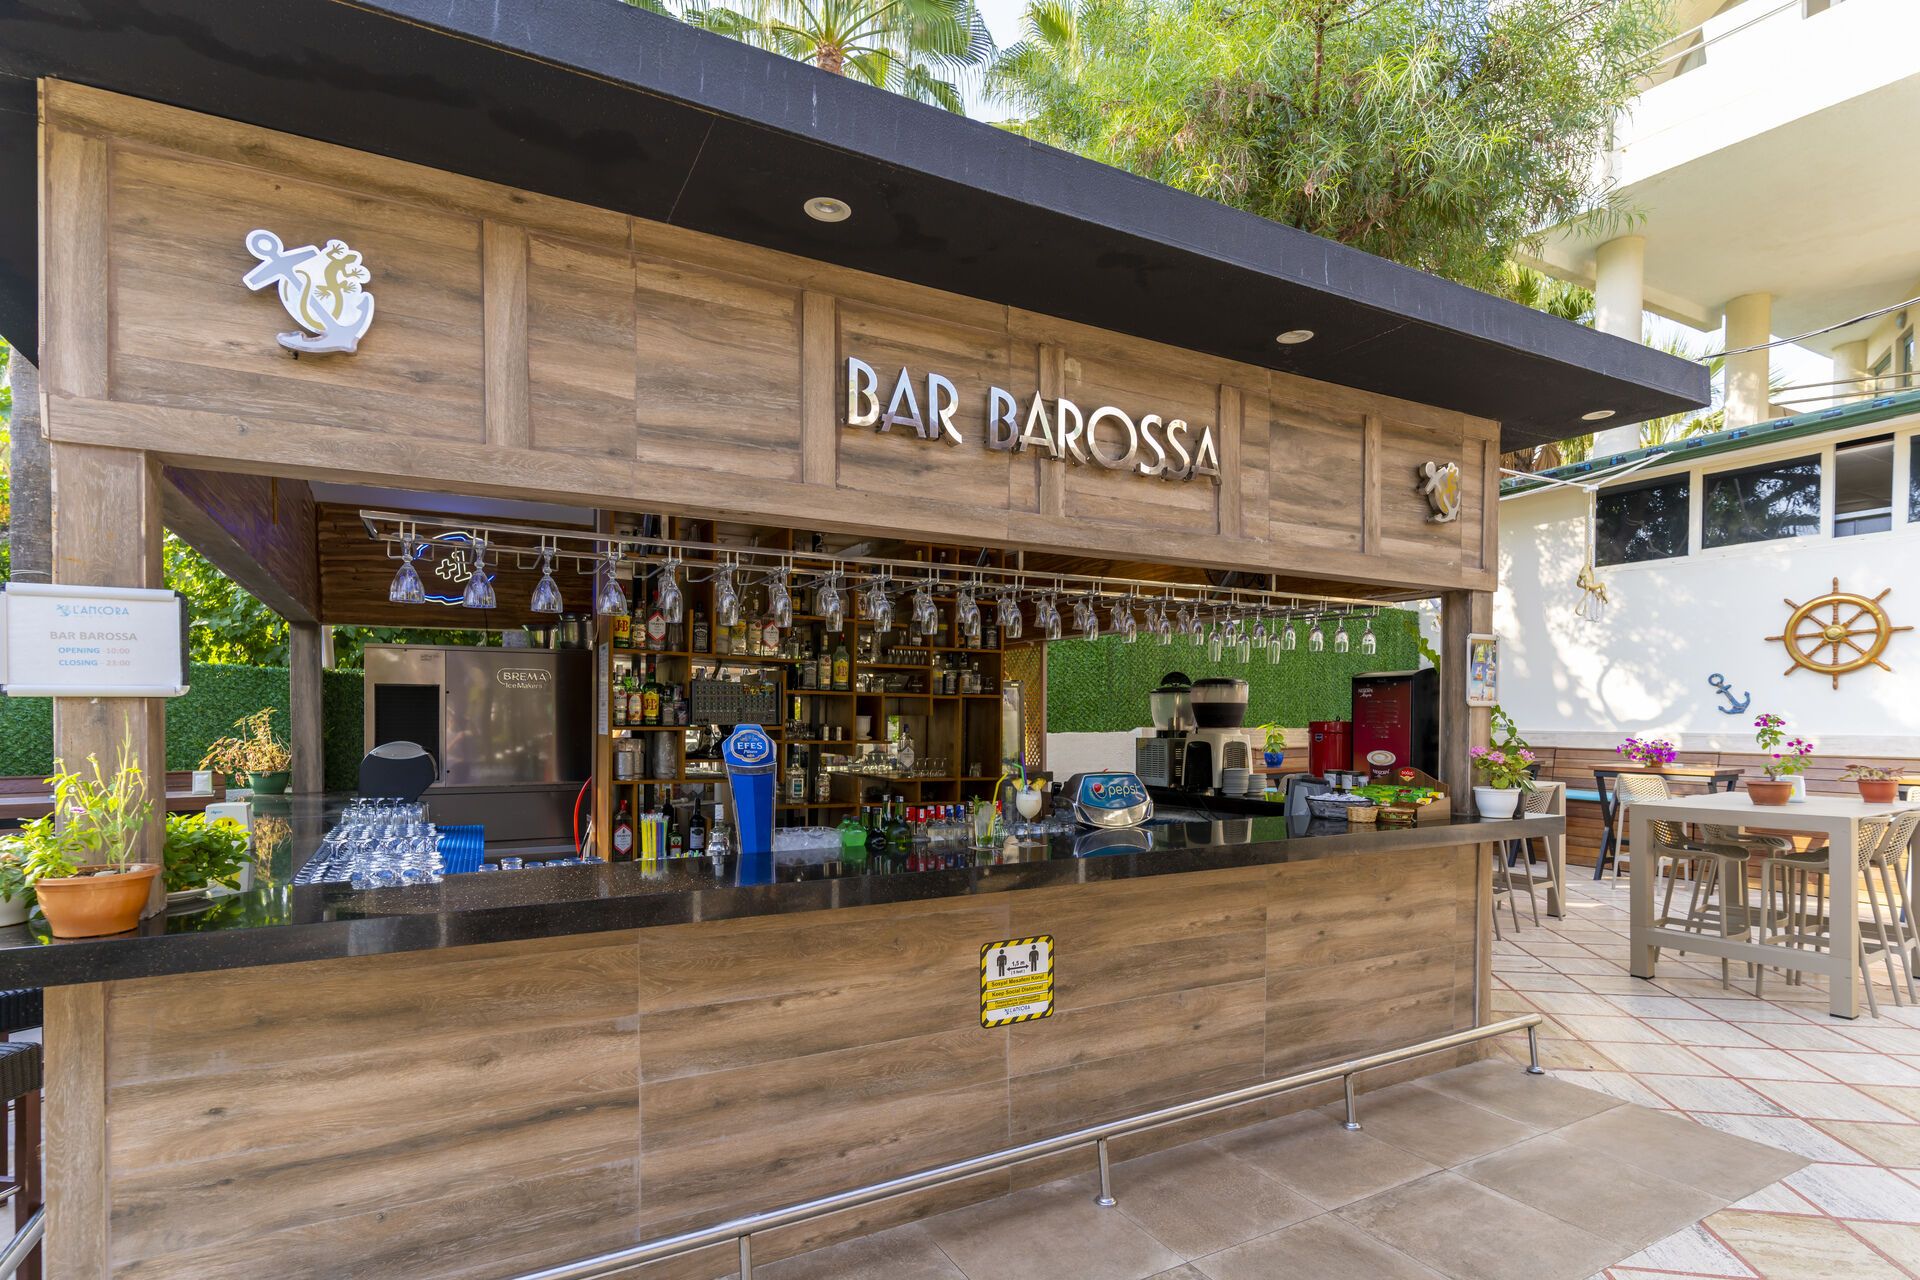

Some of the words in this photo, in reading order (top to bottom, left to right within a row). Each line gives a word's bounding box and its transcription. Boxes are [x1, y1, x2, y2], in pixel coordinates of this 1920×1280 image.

[847, 356, 963, 446] BAR
[987, 386, 1222, 487] BAROSSA
[50, 631, 76, 640] BAR
[80, 631, 138, 641] BAROSSA
[503, 672, 547, 681] BREMA
[737, 742, 763, 750] EFES
[1108, 783, 1138, 798] pepsi
